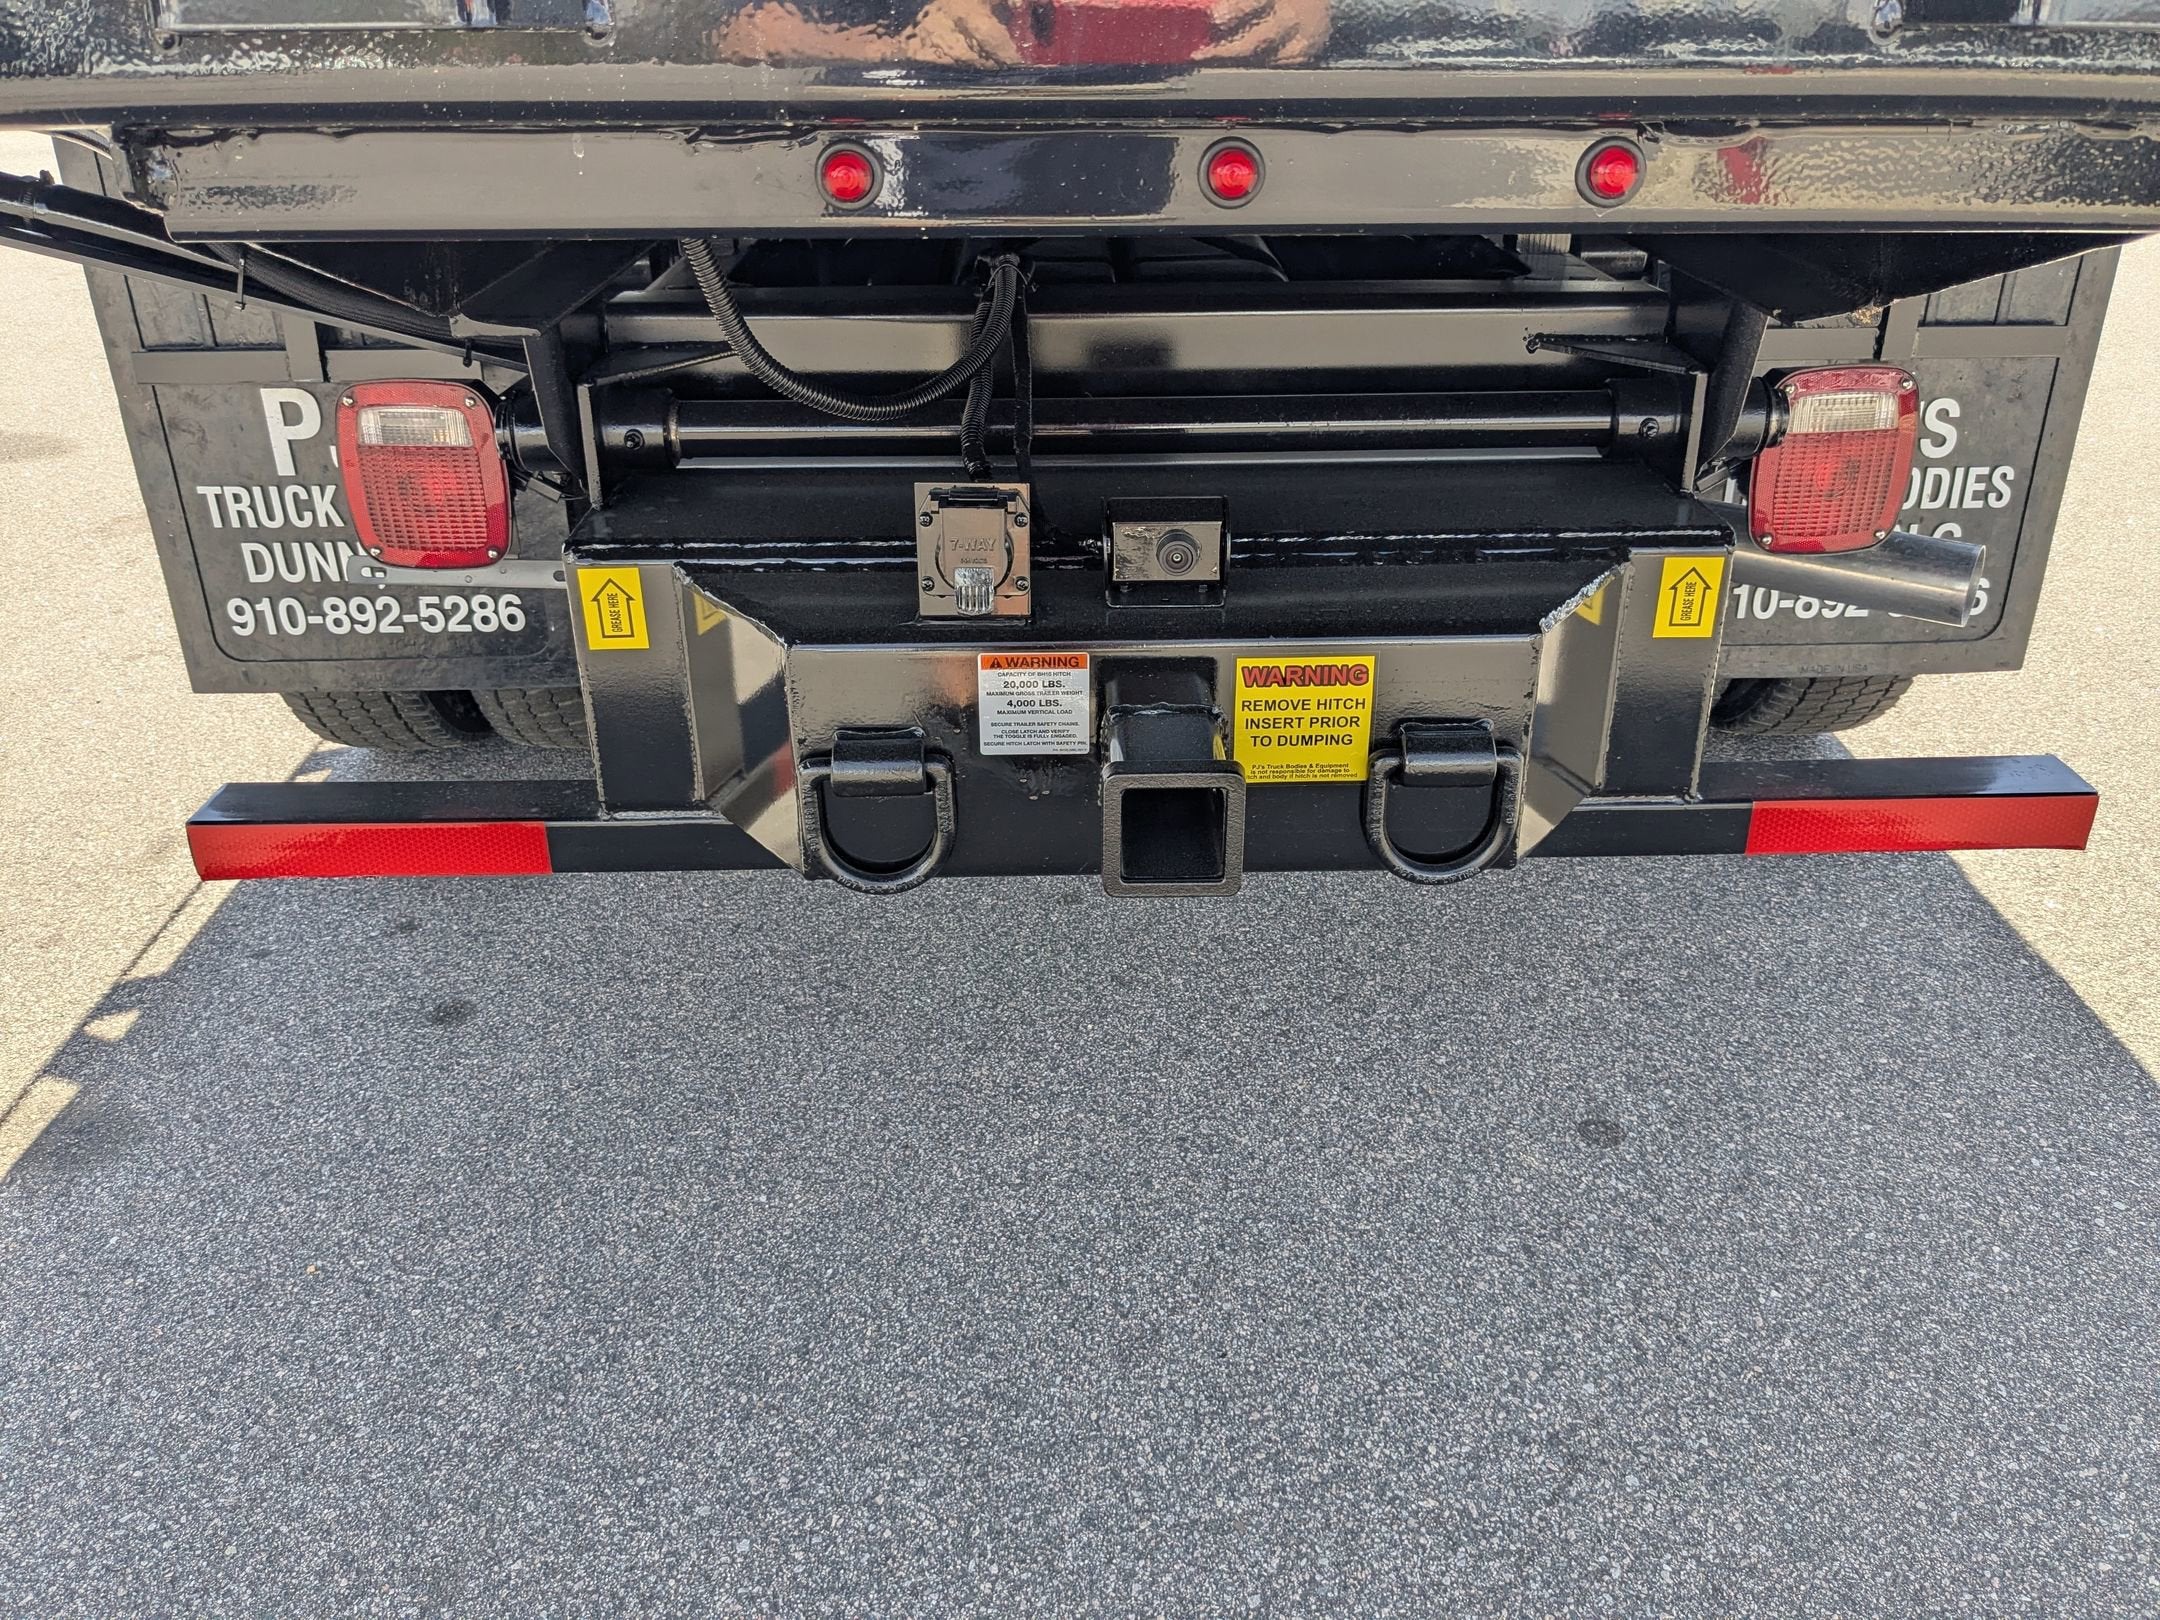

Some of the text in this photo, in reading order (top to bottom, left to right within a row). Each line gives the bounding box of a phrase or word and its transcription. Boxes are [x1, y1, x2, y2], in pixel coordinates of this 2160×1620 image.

[196, 485, 346, 529] TRUCK
[949, 537, 997, 551] 7-WAY
[1680, 581, 1697, 621] GREASE HERE
[227, 594, 527, 637] 910-892-5286
[606, 592, 624, 633] GREASE HERE
[1006, 656, 1079, 668] WARNING
[1800, 664, 1868, 673] MADE IN USA
[1241, 664, 1369, 688] WARNING
[1003, 680, 1066, 689] 20,000 LBS.
[1006, 700, 1036, 708] 4,000
[1241, 698, 1366, 712] REMOVE HITCH
[1245, 716, 1360, 730] INSERT PRIOR
[1250, 734, 1353, 747] TO DUMPING
